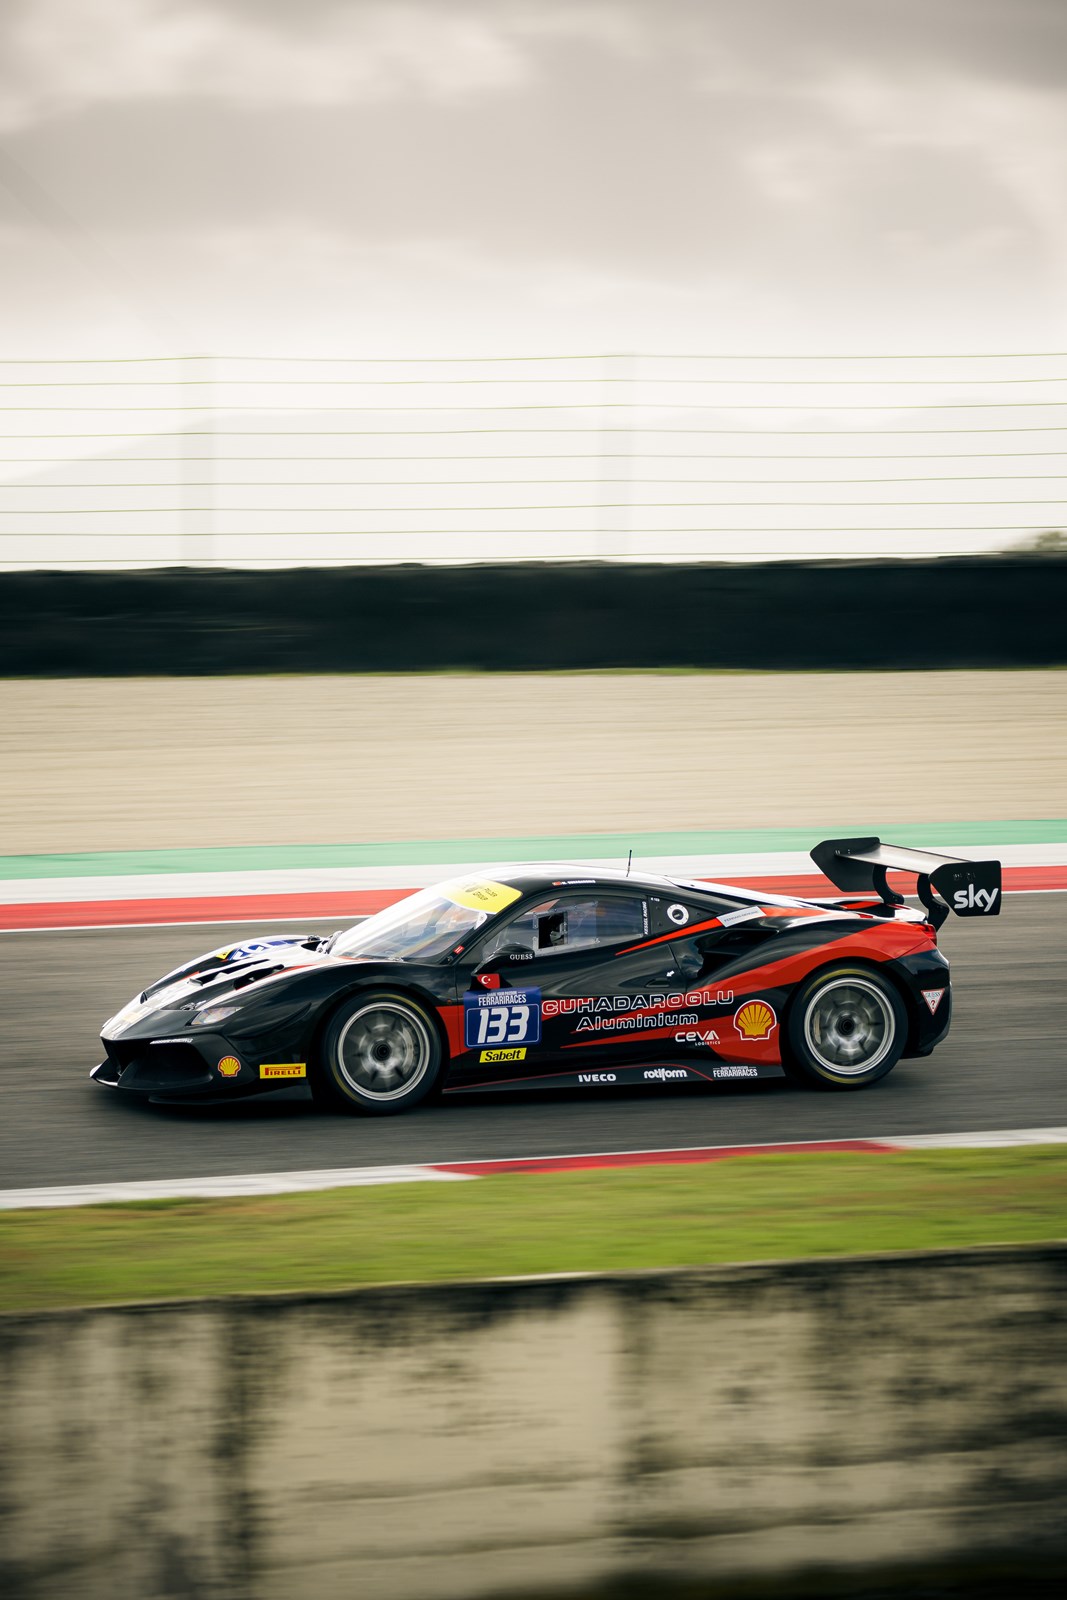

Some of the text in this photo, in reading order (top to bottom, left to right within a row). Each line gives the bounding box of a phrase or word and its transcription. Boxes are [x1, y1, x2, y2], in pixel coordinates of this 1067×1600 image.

[953, 883, 999, 912] sky
[509, 953, 533, 961] GUESS
[478, 994, 527, 1007] FERRARIRACES
[541, 990, 734, 1015] CUHADAROGLU
[477, 1005, 530, 1044] 133
[575, 1012, 699, 1031] Aluminium
[484, 1049, 521, 1062] Sabelt
[264, 1066, 301, 1076] PIRELLI
[577, 1073, 617, 1083] IVECO
